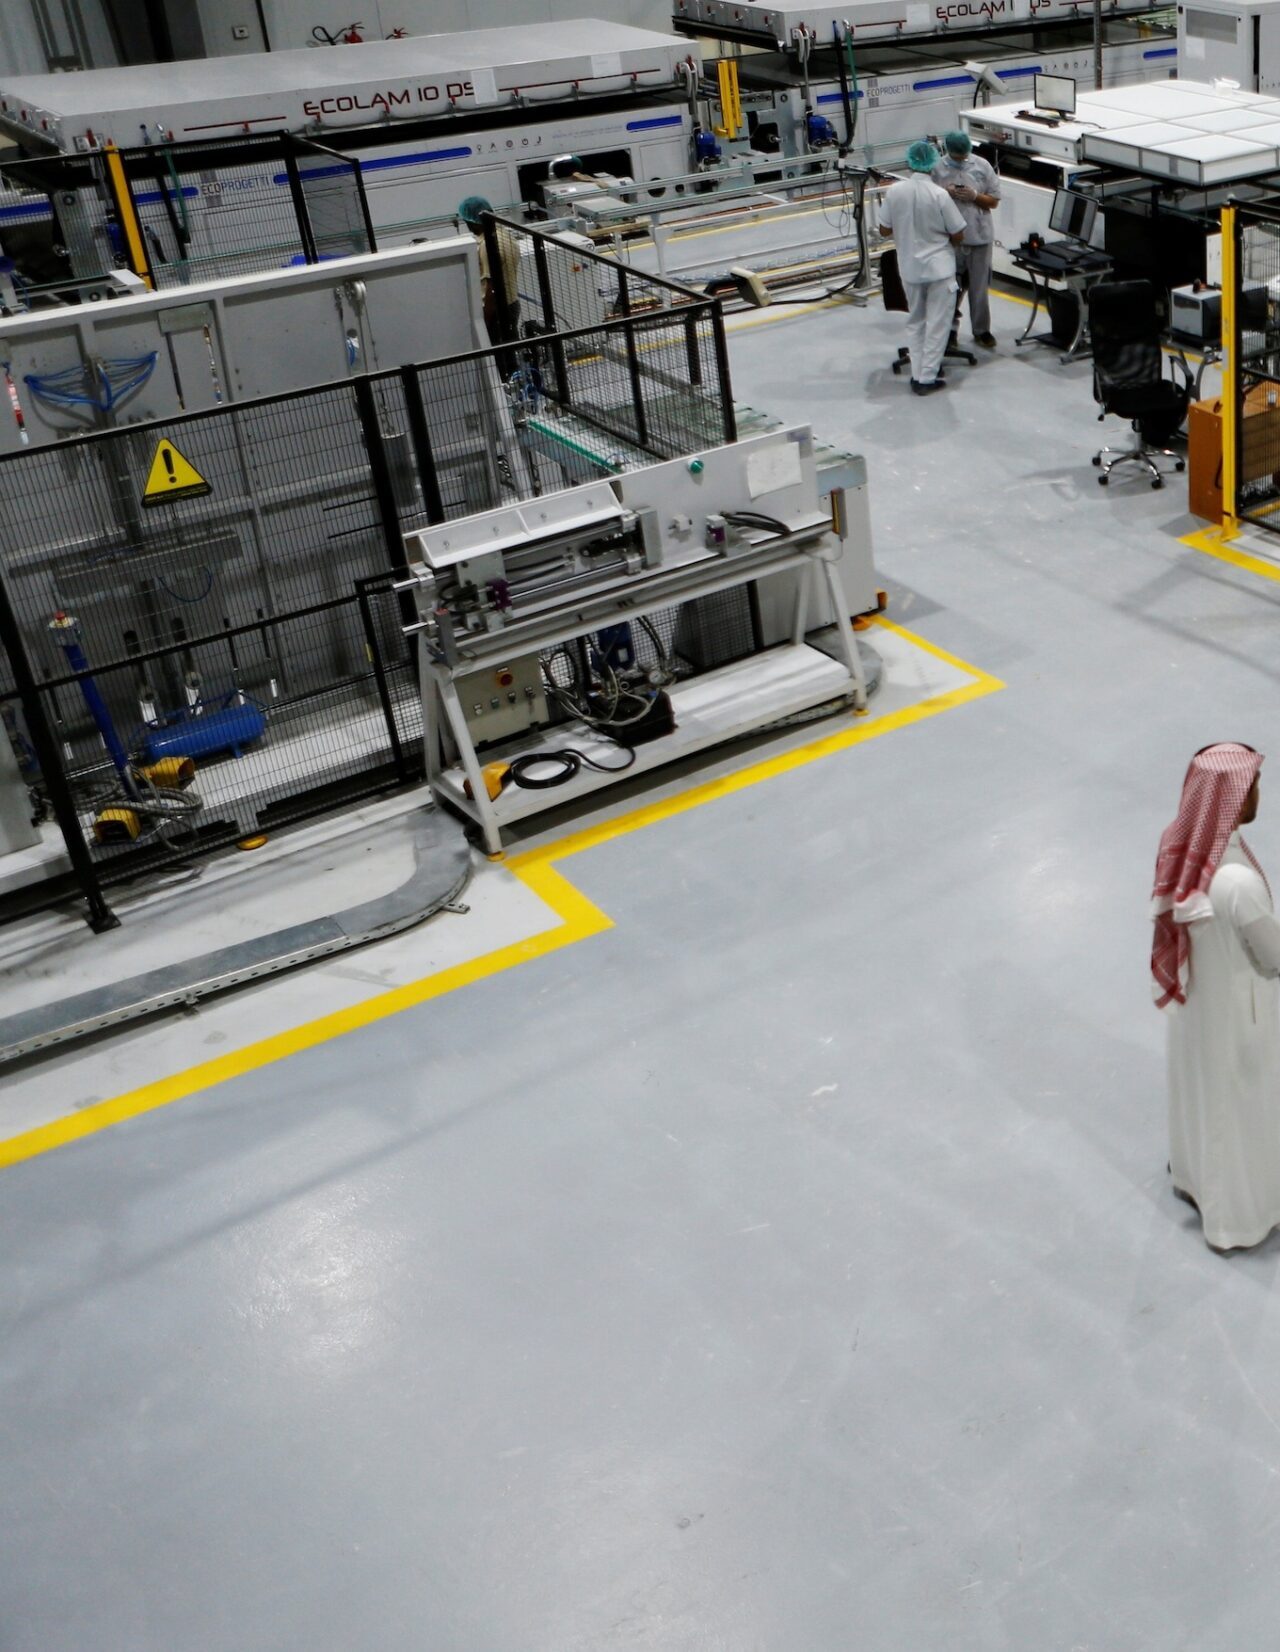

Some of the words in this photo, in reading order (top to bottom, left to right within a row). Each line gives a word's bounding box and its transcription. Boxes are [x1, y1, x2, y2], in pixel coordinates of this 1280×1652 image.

[936, 1, 1005, 18] ECOLAM
[303, 89, 410, 116] ECOLAM
[446, 82, 475, 99] DS
[202, 176, 270, 195] ECOPROGETTI
